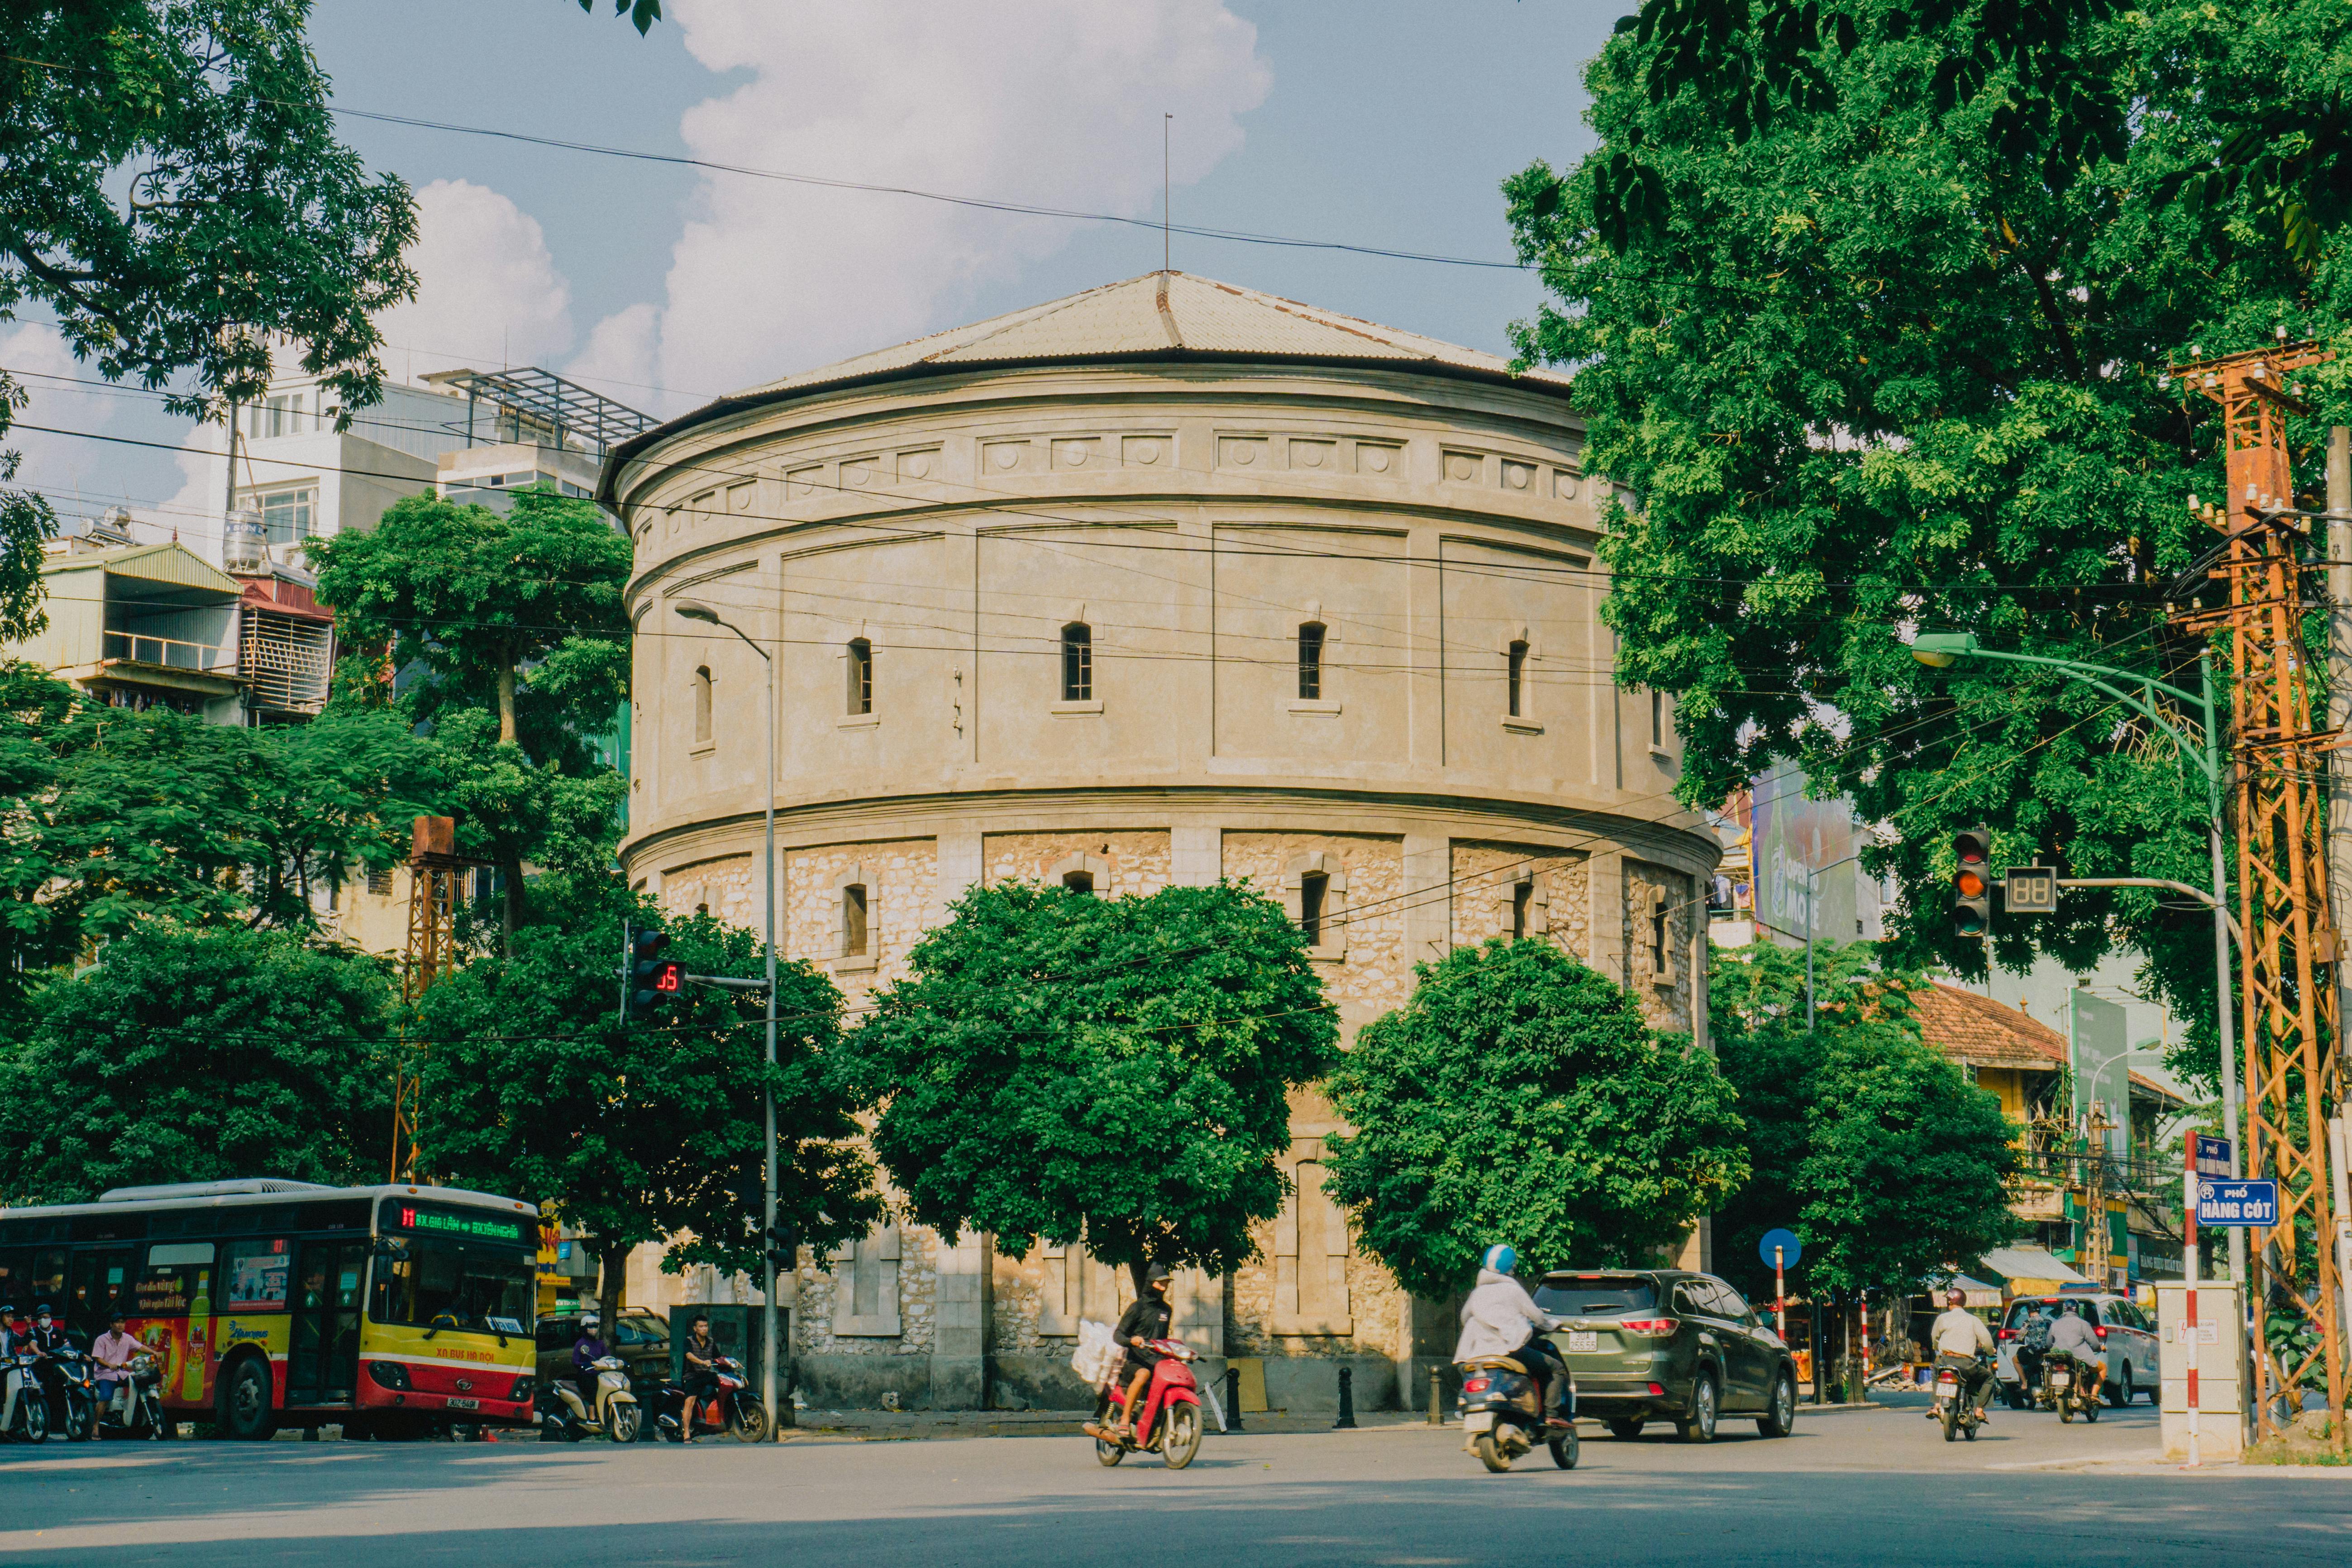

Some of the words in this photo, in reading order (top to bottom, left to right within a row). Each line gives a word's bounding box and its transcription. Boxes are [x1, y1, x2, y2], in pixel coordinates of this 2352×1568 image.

[1787, 858, 1808, 887] OPEN
[2206, 1144, 2218, 1154] PHỐ
[2224, 1185, 2248, 1198] PHỐ
[2202, 1199, 2240, 1219] HÀNG
[2243, 1199, 2272, 1219] CÓT
[443, 1216, 459, 1231] LÂM
[1576, 1332, 1590, 1341] 30A
[450, 1349, 465, 1359] BUS
